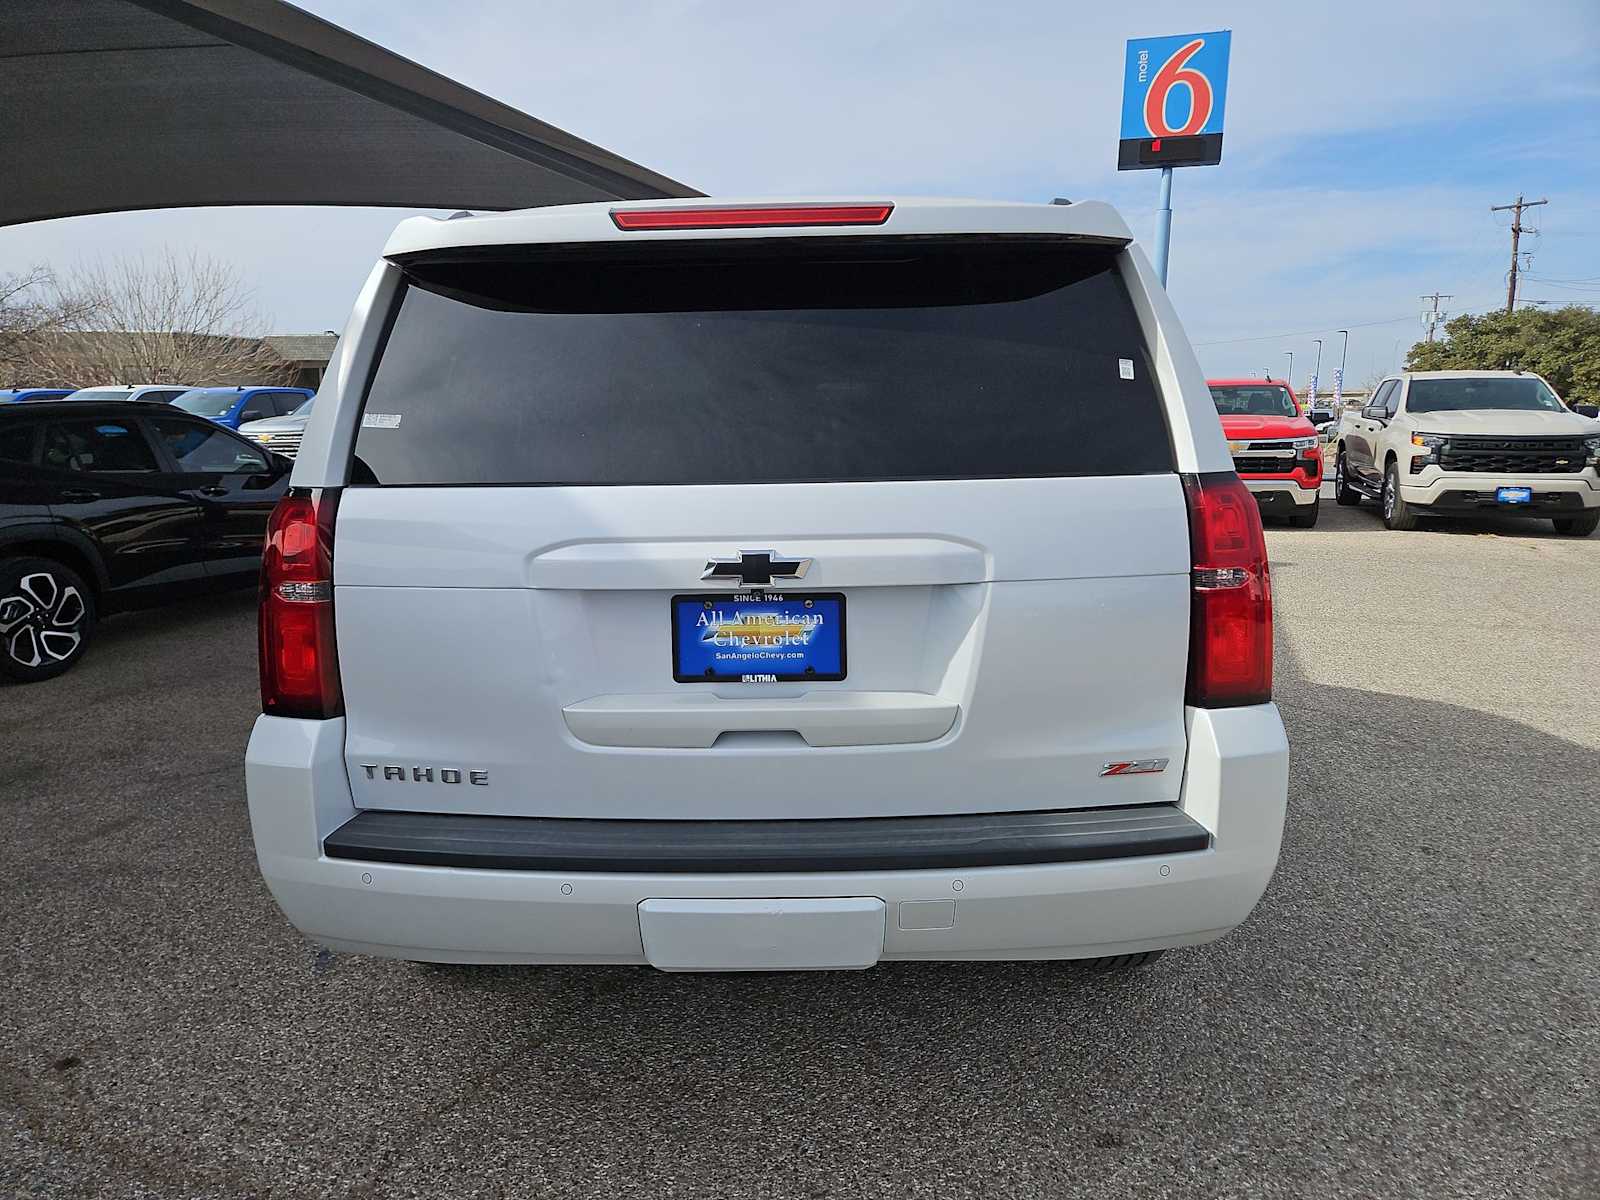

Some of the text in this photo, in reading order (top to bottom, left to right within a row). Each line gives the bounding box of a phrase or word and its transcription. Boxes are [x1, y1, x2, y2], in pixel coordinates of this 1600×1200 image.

[1137, 49, 1149, 83] motel
[1143, 38, 1214, 138] 6
[733, 594, 784, 602] SINCE 1946
[695, 610, 824, 627] All American
[713, 630, 810, 647] Chevrolet
[715, 651, 805, 660] SanAngeloChevy.com
[360, 763, 489, 786] TAHOE
